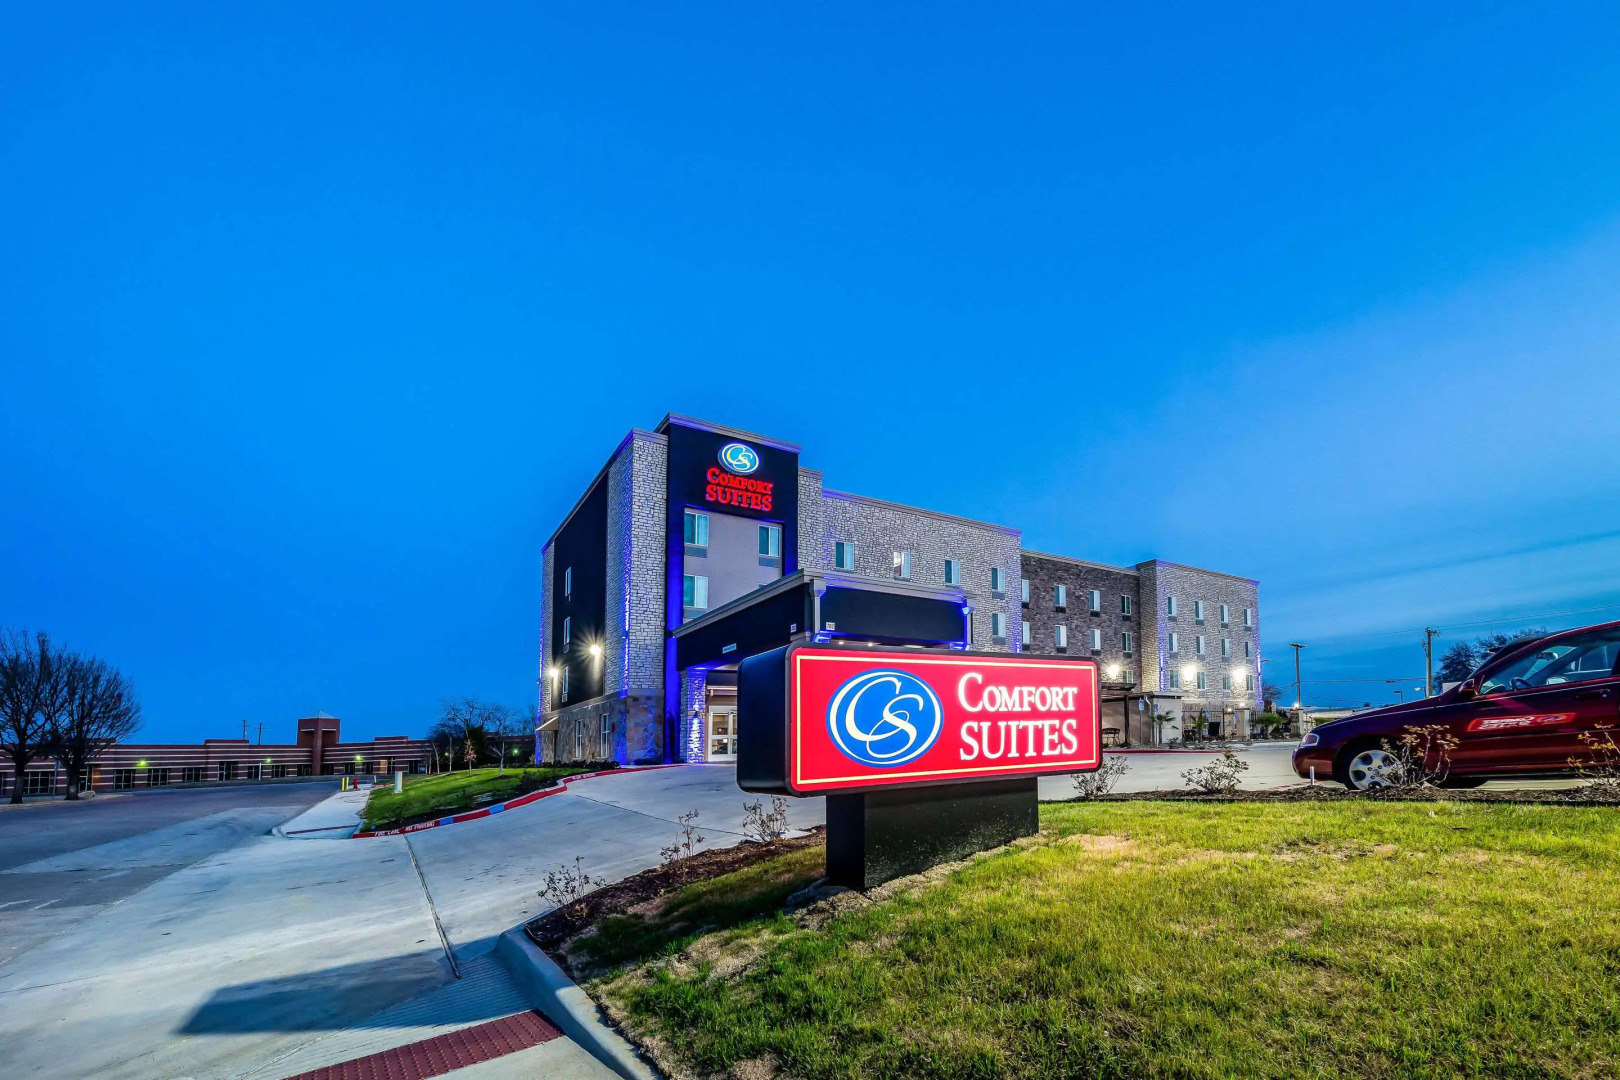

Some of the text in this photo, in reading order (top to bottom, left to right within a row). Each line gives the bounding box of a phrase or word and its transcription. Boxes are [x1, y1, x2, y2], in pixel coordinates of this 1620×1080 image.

[705, 484, 772, 511] SUITES
[706, 468, 773, 494] COMFORT
[957, 672, 1078, 713] COMFORT
[959, 719, 1078, 761] SUITES
